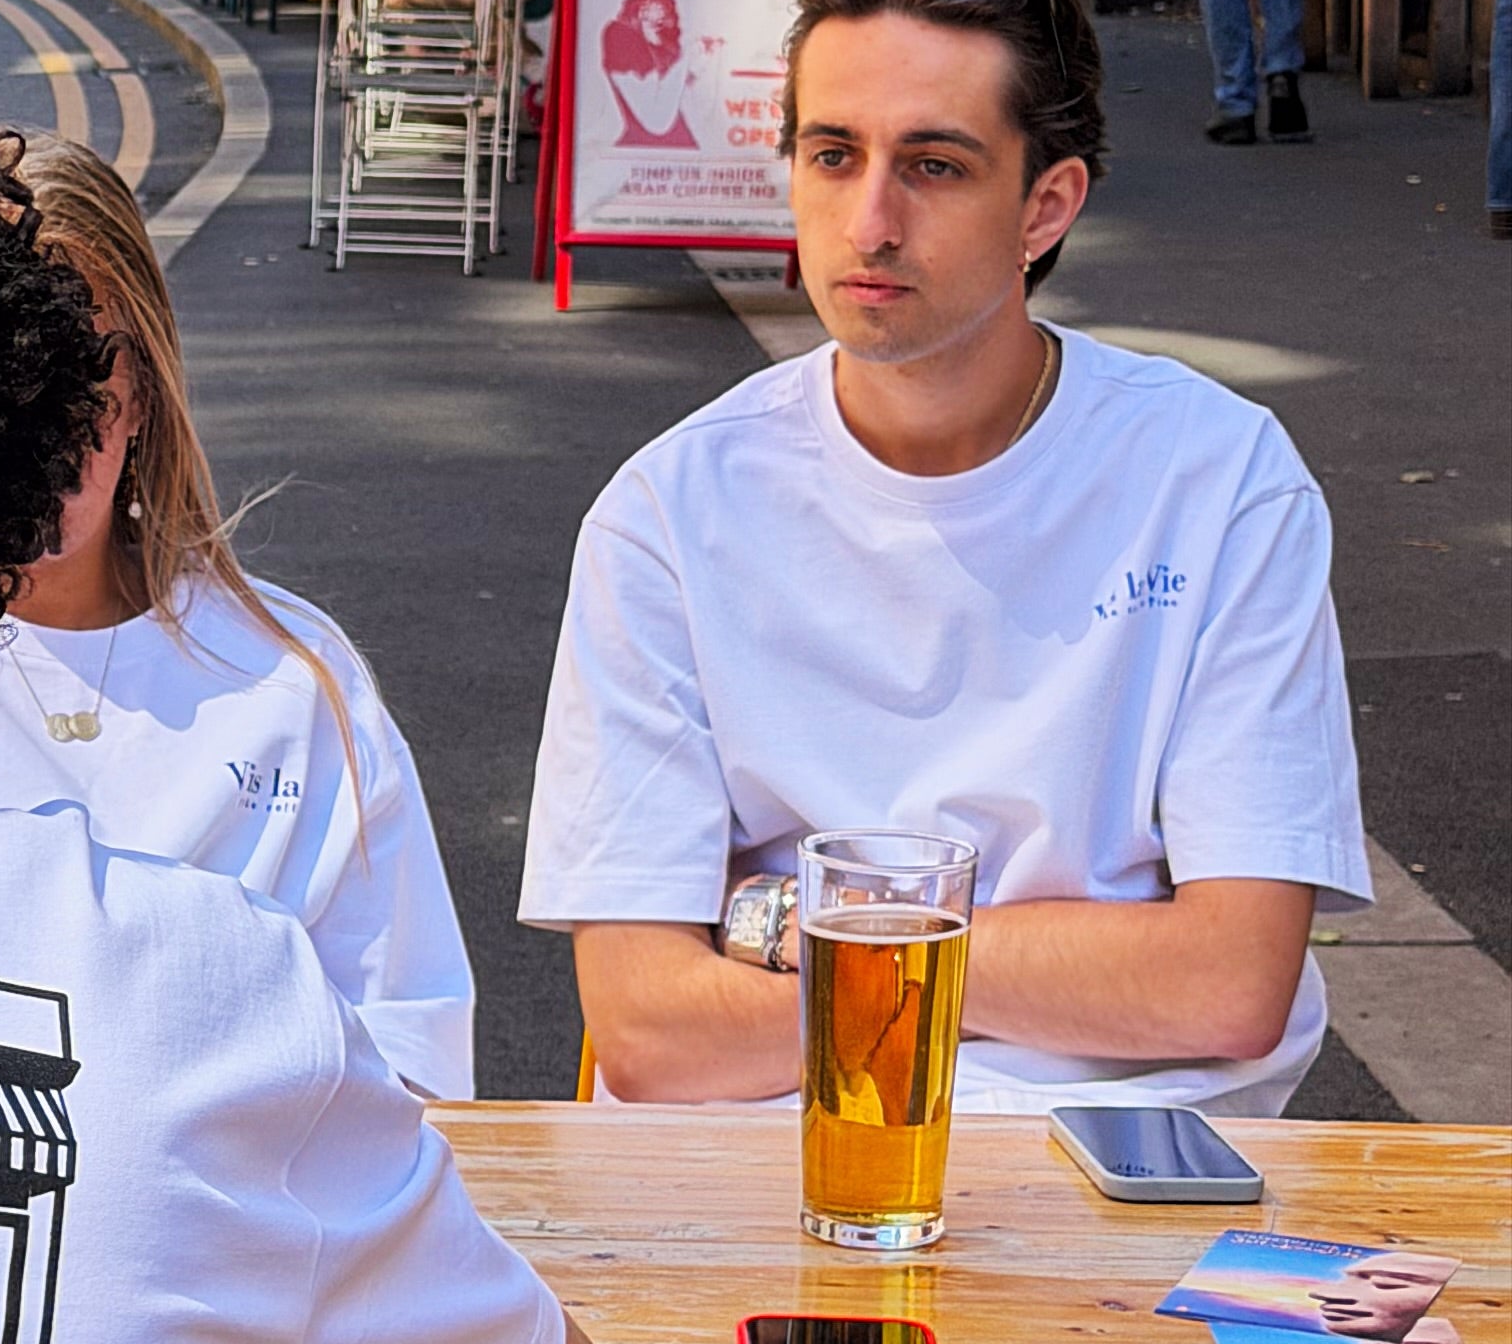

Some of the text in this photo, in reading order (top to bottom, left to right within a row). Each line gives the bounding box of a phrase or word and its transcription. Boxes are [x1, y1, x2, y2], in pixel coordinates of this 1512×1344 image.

[727, 127, 777, 146] OPE
[224, 760, 300, 798] Vis la
